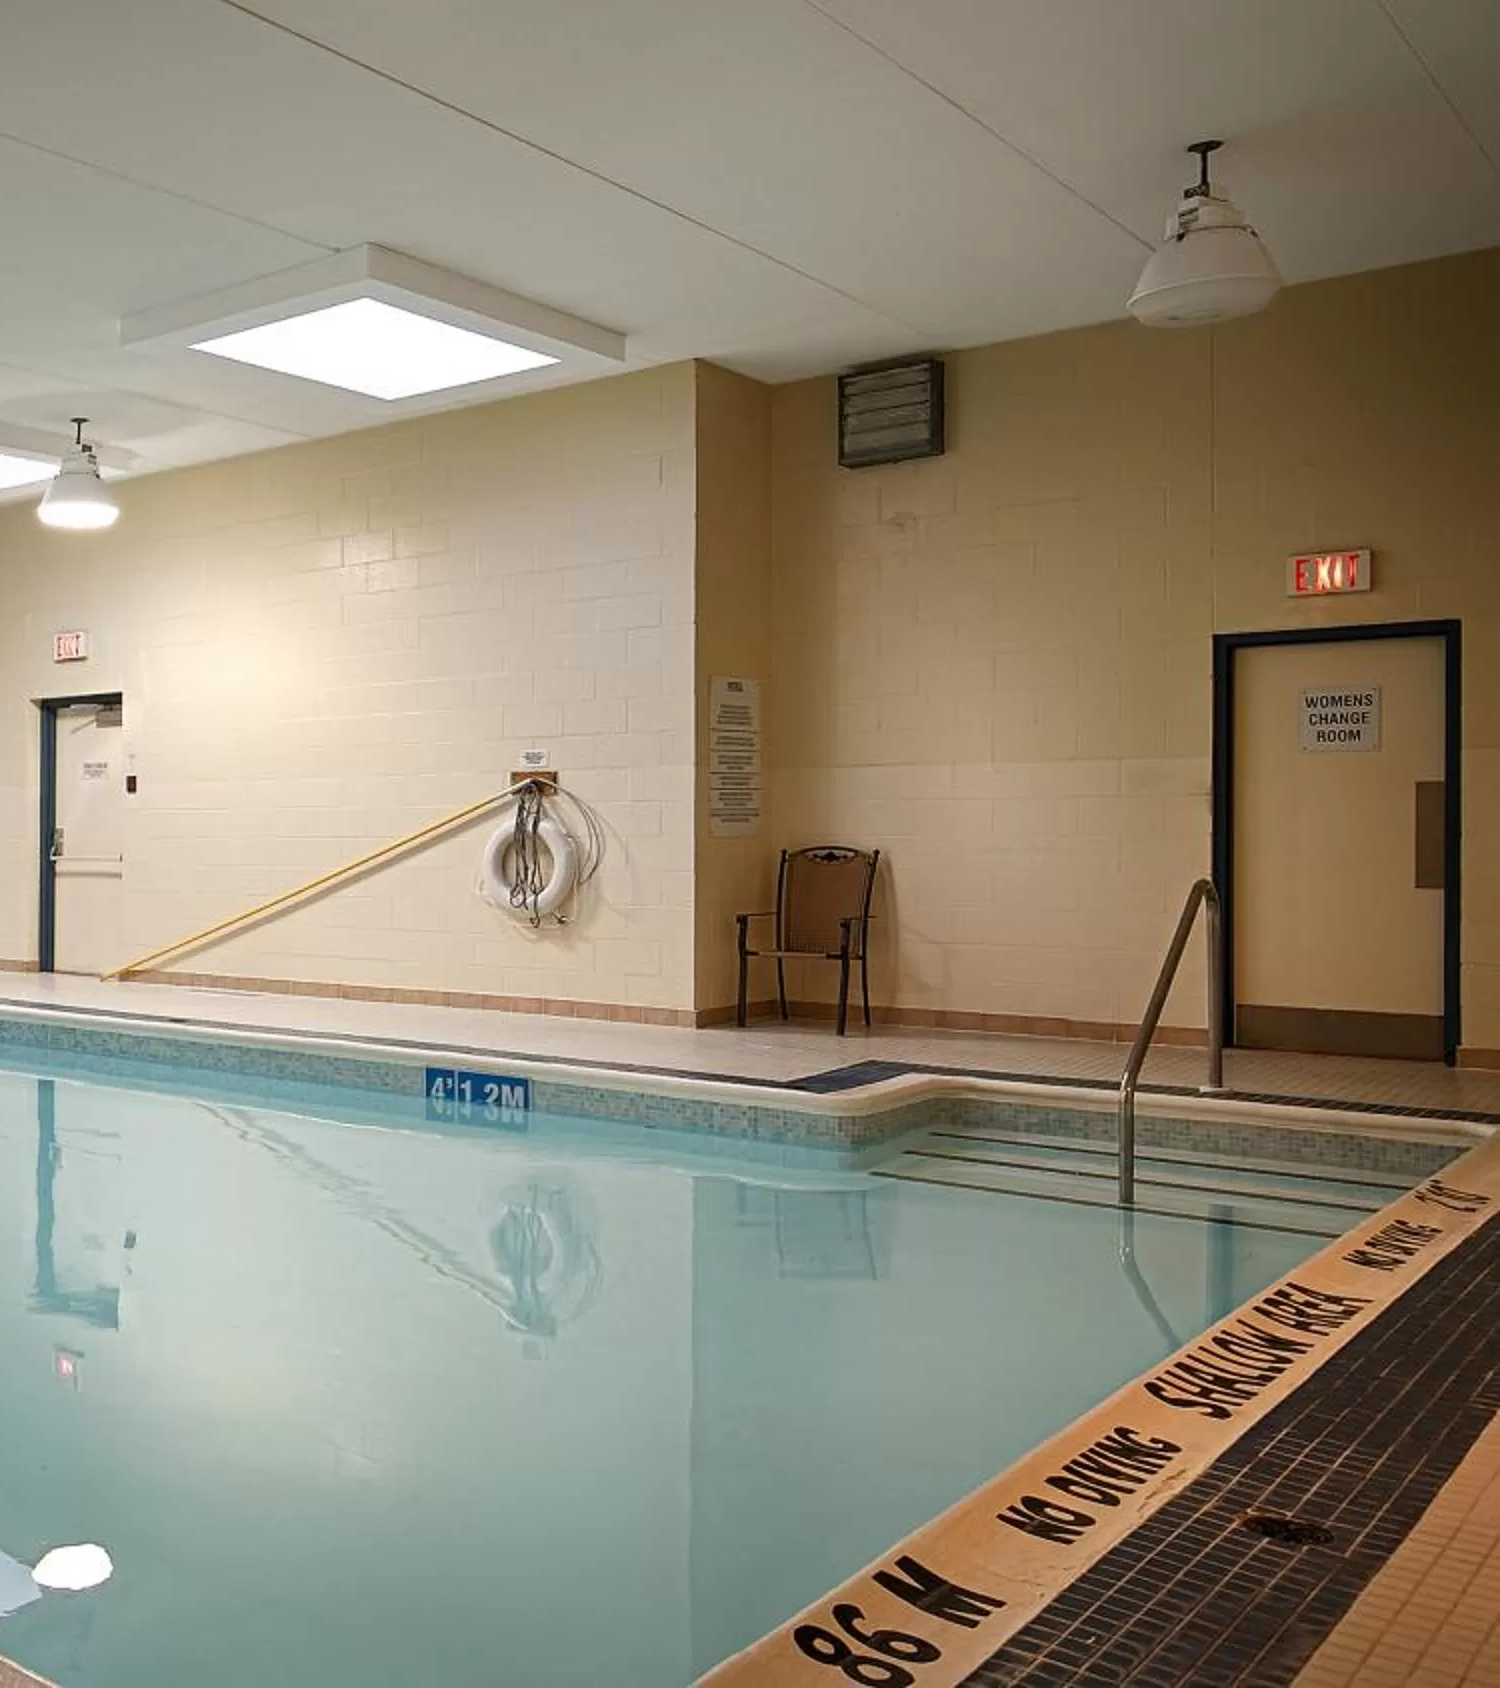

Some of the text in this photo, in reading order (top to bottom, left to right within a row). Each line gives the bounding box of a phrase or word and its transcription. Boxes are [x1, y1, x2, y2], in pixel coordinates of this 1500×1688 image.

[1294, 553, 1360, 592] EXIT
[1305, 693, 1373, 709] WOMENS
[1308, 711, 1371, 727] CHANGE
[1316, 729, 1362, 744] ROOM
[1342, 1218, 1444, 1272] NO DIVING
[1144, 1281, 1375, 1420] SHALLOW AREA
[996, 1426, 1183, 1545] NO DIVING
[793, 1555, 1007, 1688] 86 M
